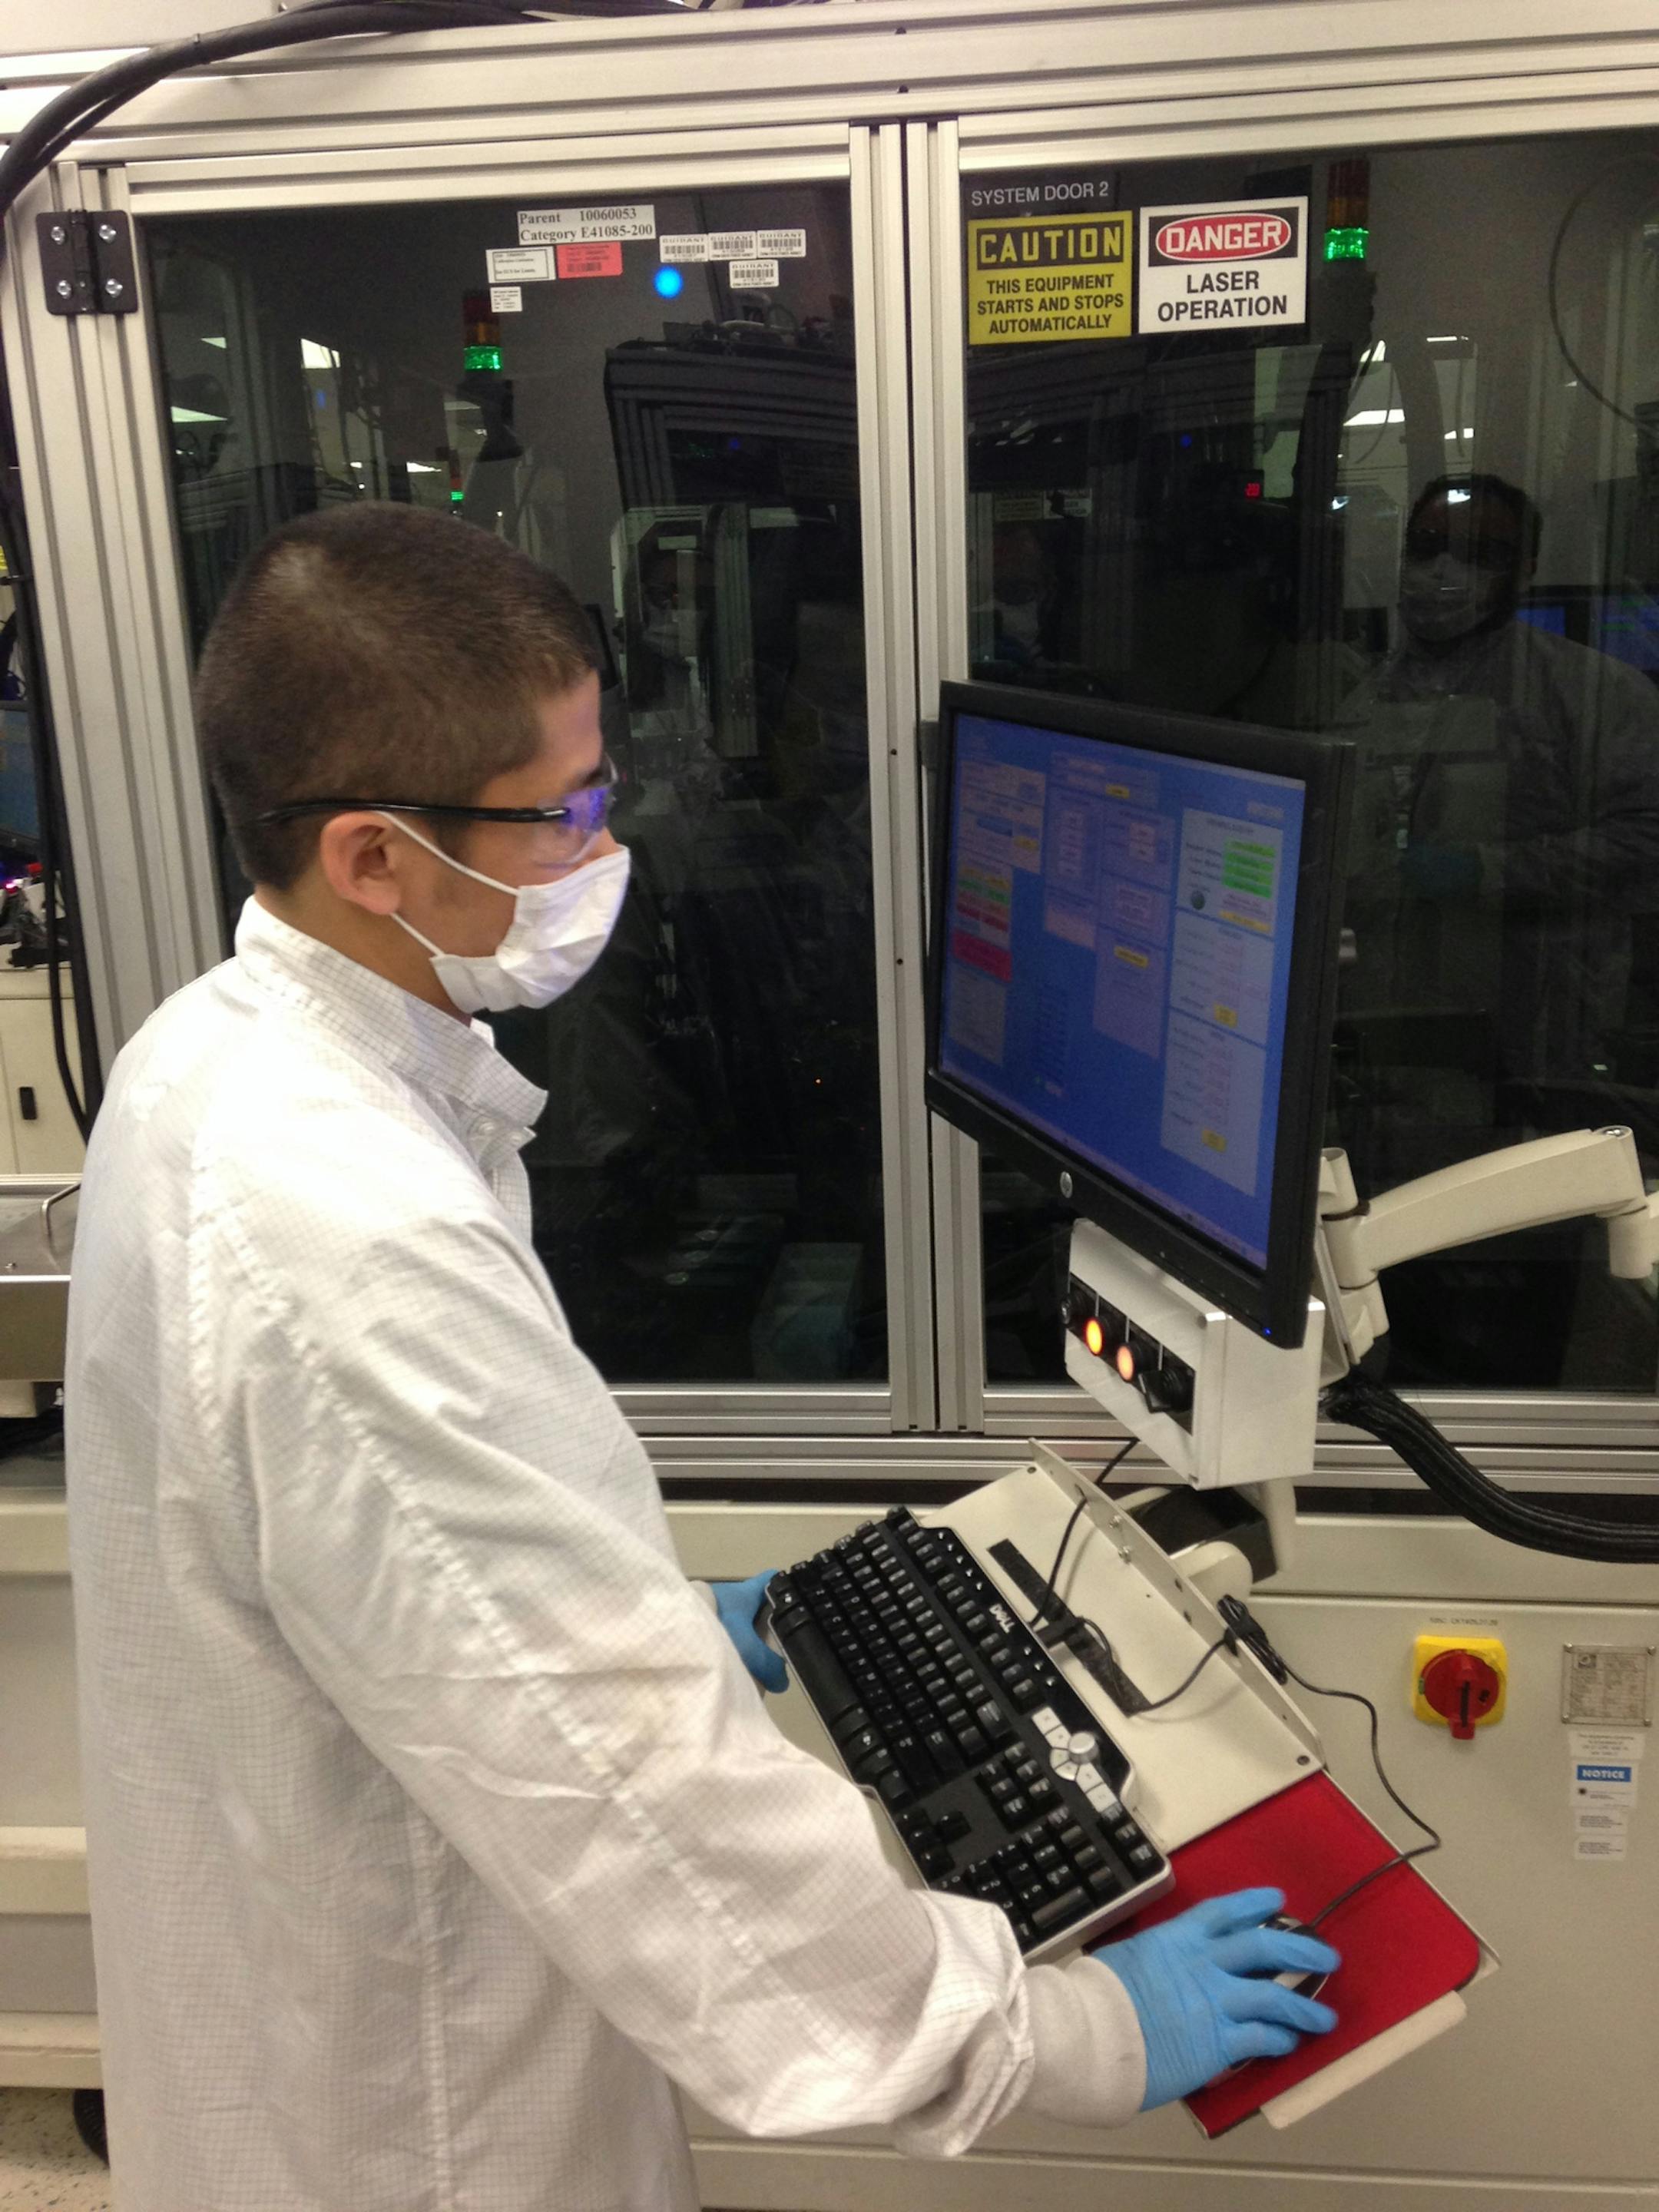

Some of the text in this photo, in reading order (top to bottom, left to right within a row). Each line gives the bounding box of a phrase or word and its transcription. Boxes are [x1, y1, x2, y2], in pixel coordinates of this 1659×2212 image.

[971, 180, 1109, 207] SYSTEM DOOR 2
[519, 207, 637, 225] Parent 10060053
[520, 224, 653, 243] Category E41085-200
[979, 227, 1121, 263] CAUTION
[1165, 220, 1283, 253] DANGER
[987, 273, 1114, 294] THIS EQUIPMENT
[1187, 270, 1260, 294] LASER
[977, 293, 1124, 316] STARTS AND STOPS
[1157, 295, 1287, 323] OPERATION
[988, 313, 1112, 334] AUTOMATICALLY
[988, 1603, 1015, 1634] DELL
[1582, 1769, 1625, 1779] NOTICE
